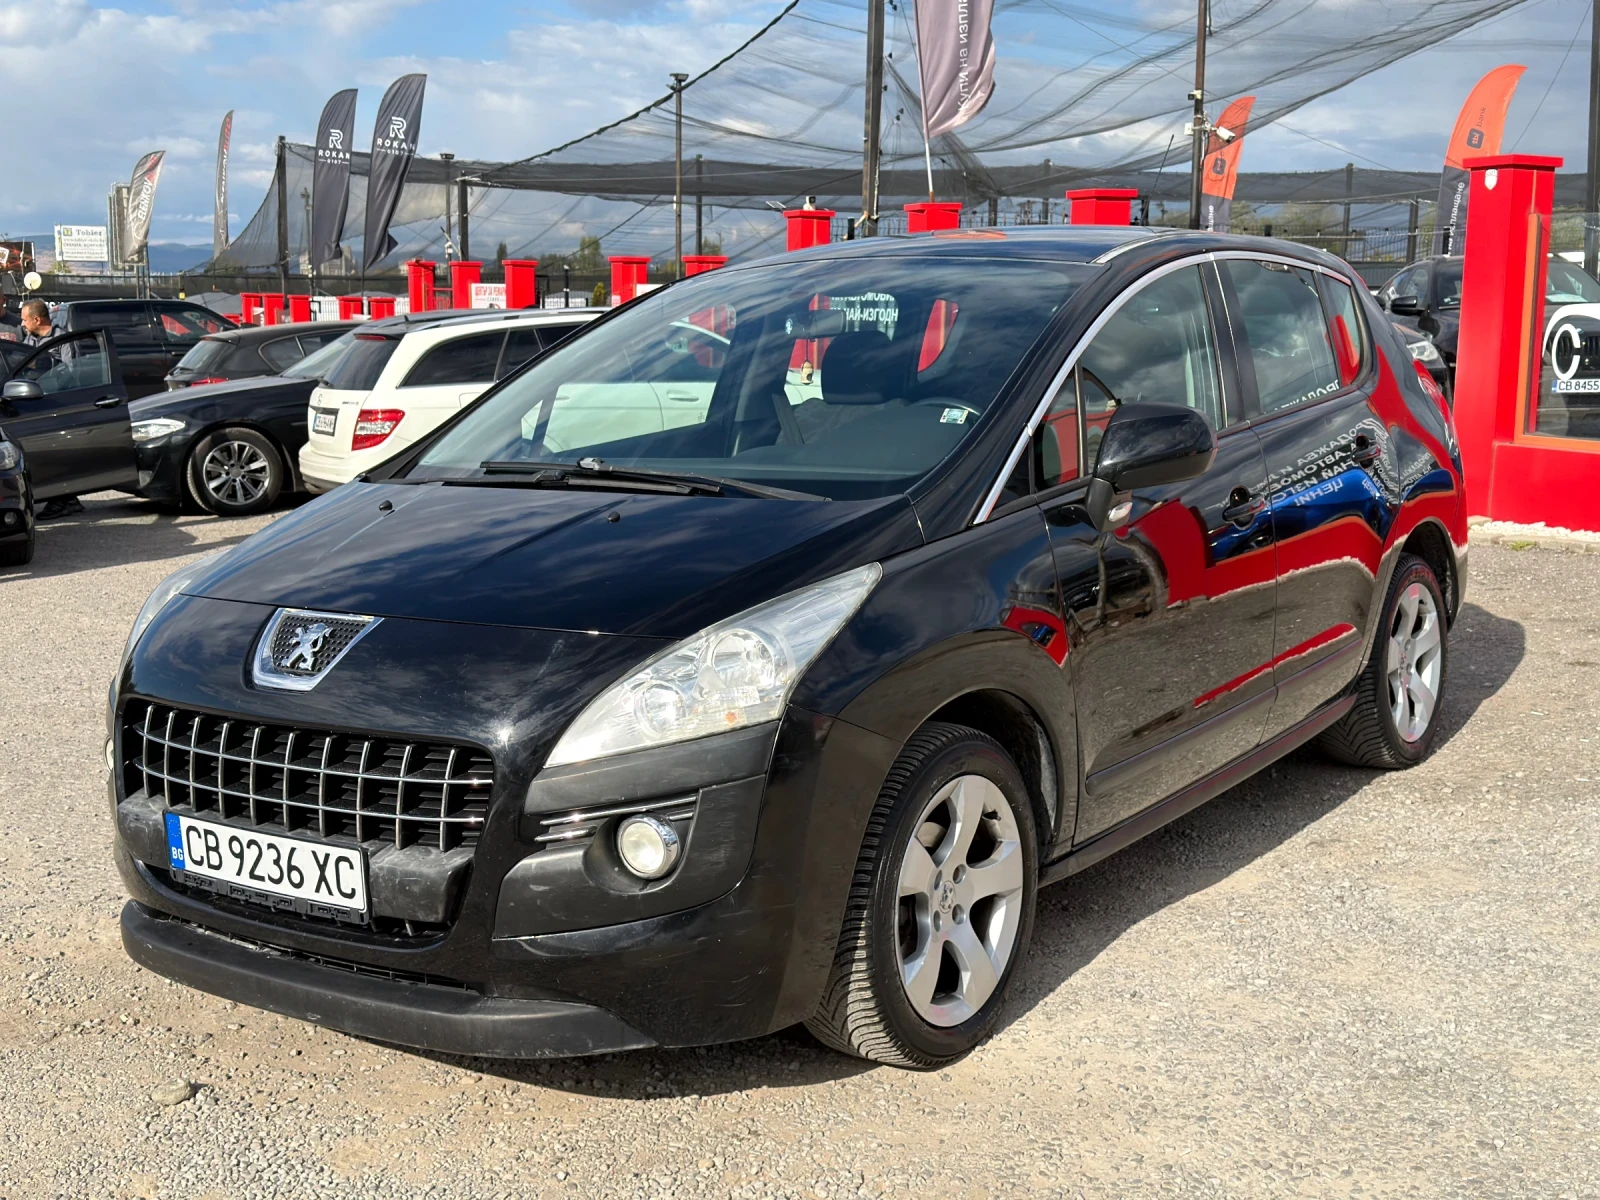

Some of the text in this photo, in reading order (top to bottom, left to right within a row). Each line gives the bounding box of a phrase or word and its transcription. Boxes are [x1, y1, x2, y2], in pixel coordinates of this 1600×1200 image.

[957, 0, 969, 44] изпл
[376, 138, 416, 150] ROKAN
[318, 149, 350, 160] ROKAN
[137, 178, 154, 221] ELENKOV
[1574, 380, 1600, 391] 8455
[171, 846, 184, 861] BG
[186, 825, 357, 899] CB 9236 XC
